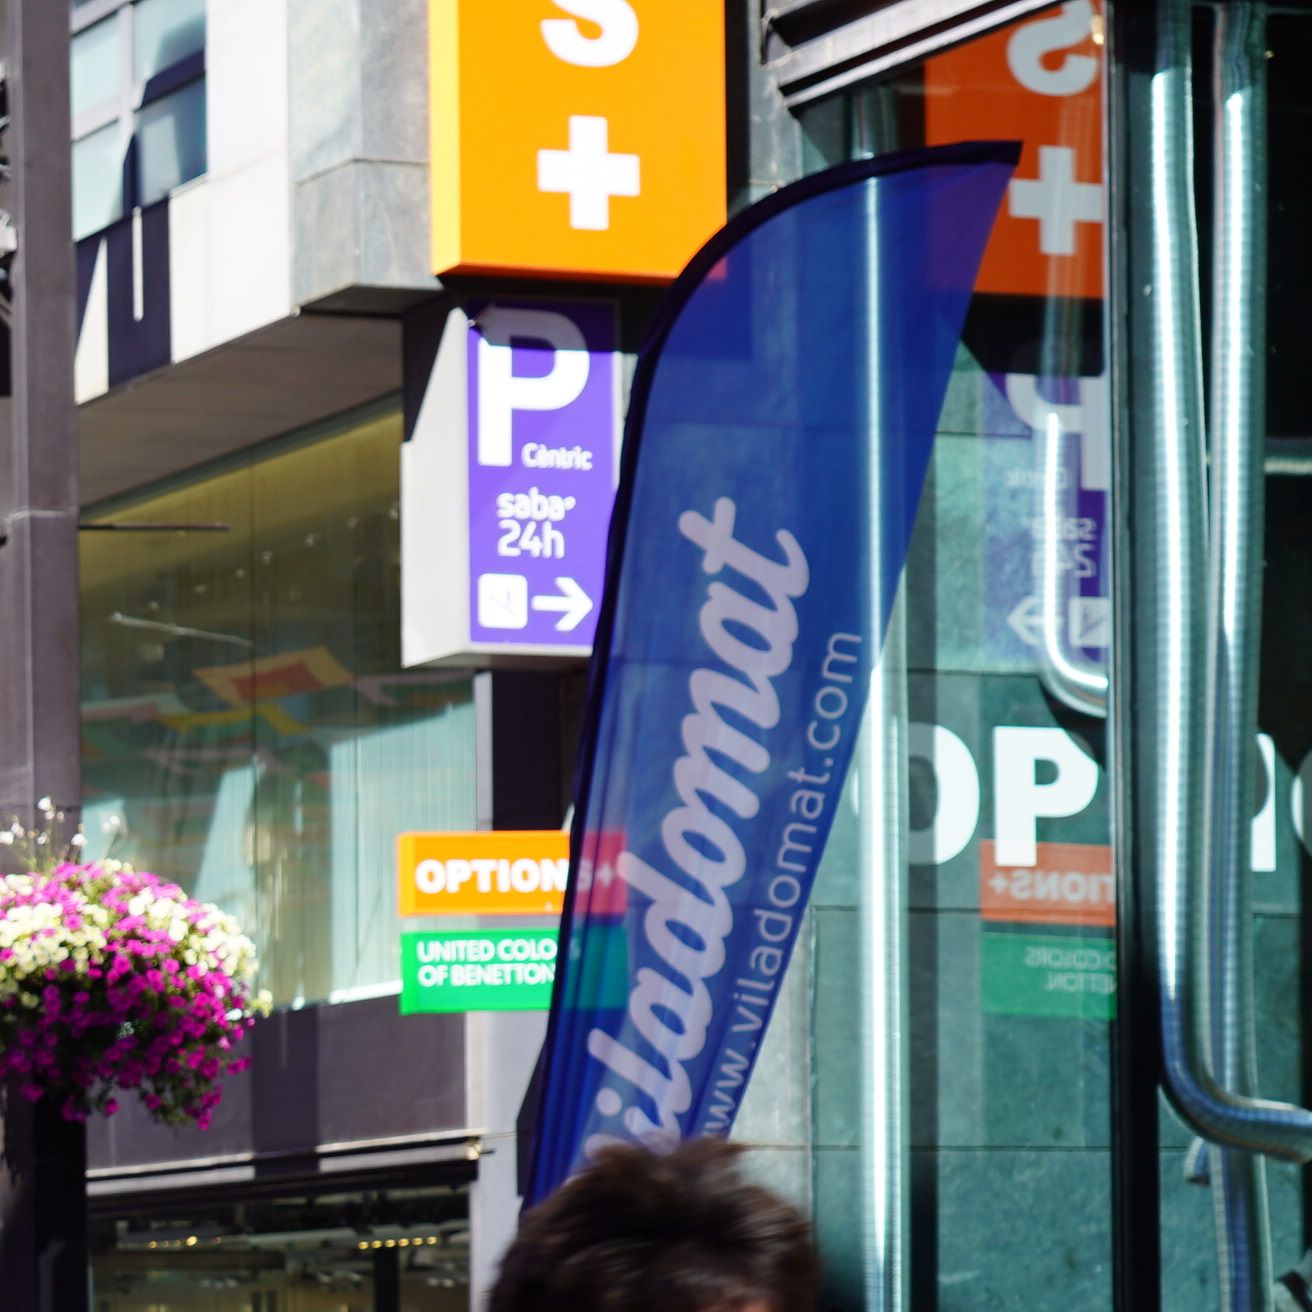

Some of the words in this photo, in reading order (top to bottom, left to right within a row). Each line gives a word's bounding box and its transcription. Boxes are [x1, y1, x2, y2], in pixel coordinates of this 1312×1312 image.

[477, 305, 590, 467] P
[497, 519, 565, 560] 24h
[416, 938, 495, 962] UNITED
[417, 965, 449, 987] OF
